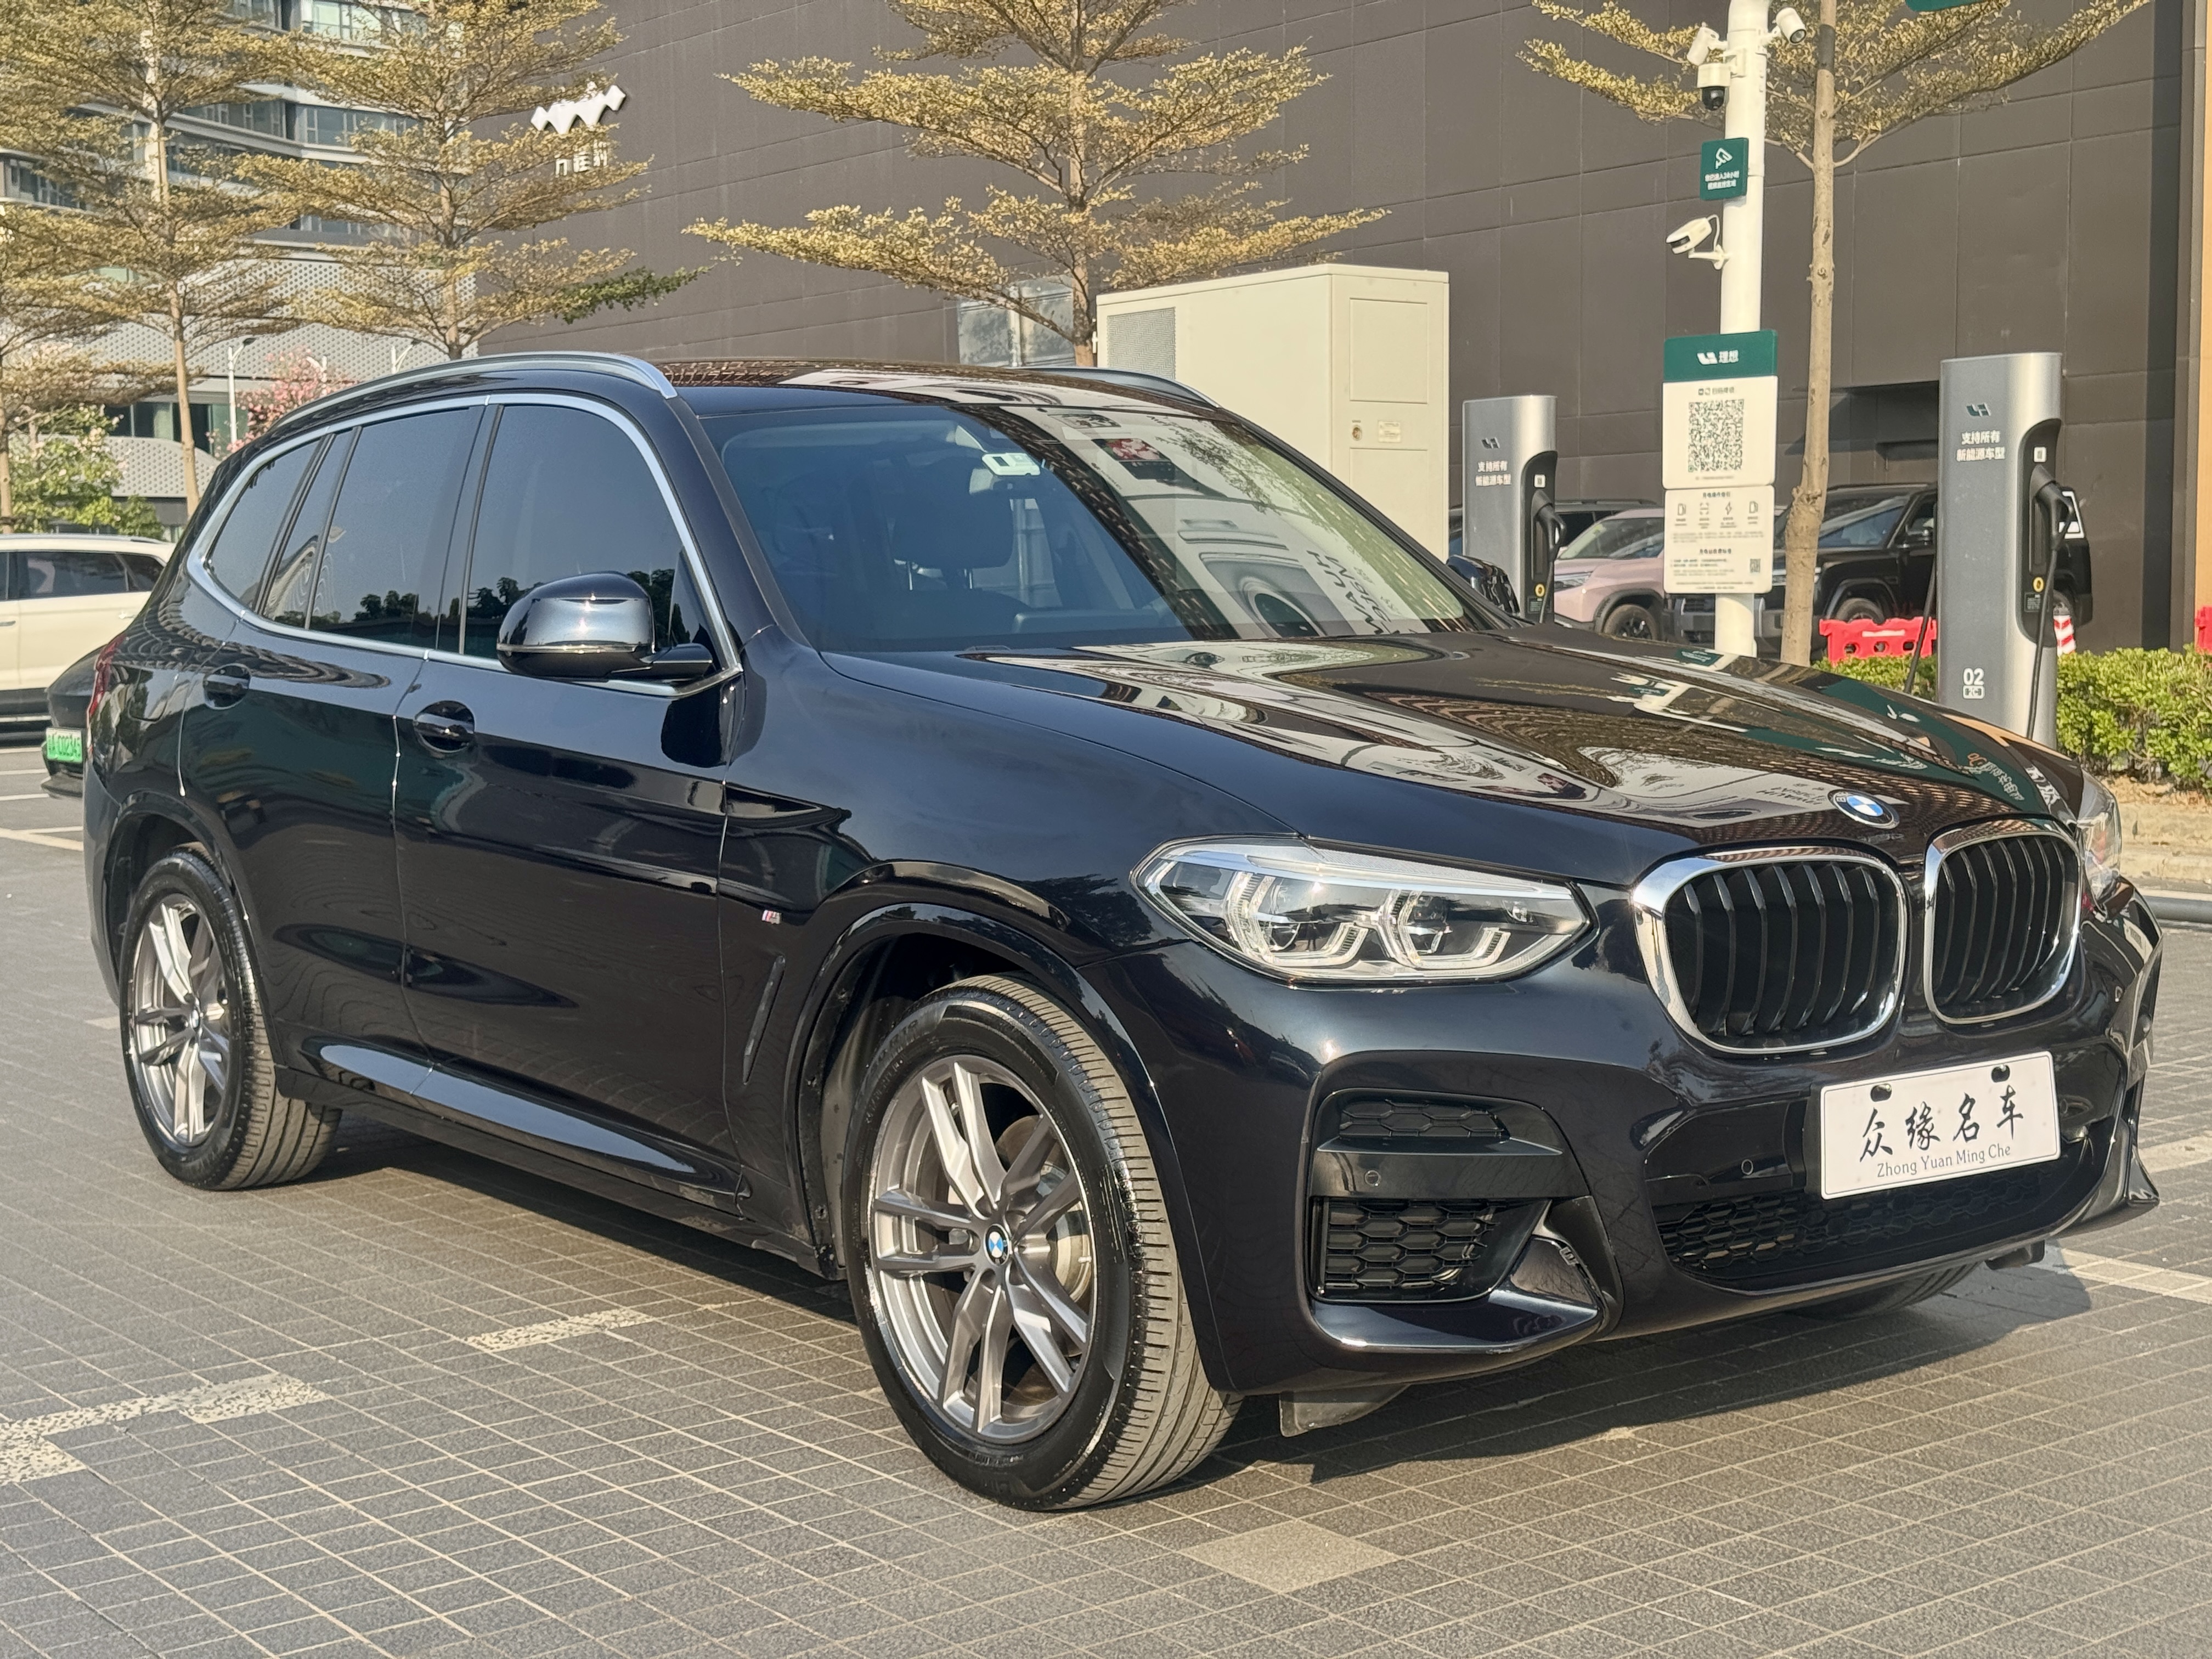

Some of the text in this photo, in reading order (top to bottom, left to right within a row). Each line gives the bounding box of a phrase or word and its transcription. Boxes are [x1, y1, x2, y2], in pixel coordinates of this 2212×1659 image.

[1961, 430, 2000, 445] 支持所有
[1956, 447, 2005, 462] 新能源车型
[1963, 668, 1984, 686] 02
[1860, 1085, 2023, 1163] 众缘名车
[1877, 1144, 2011, 1178] Zhong Yuan Ming Che
